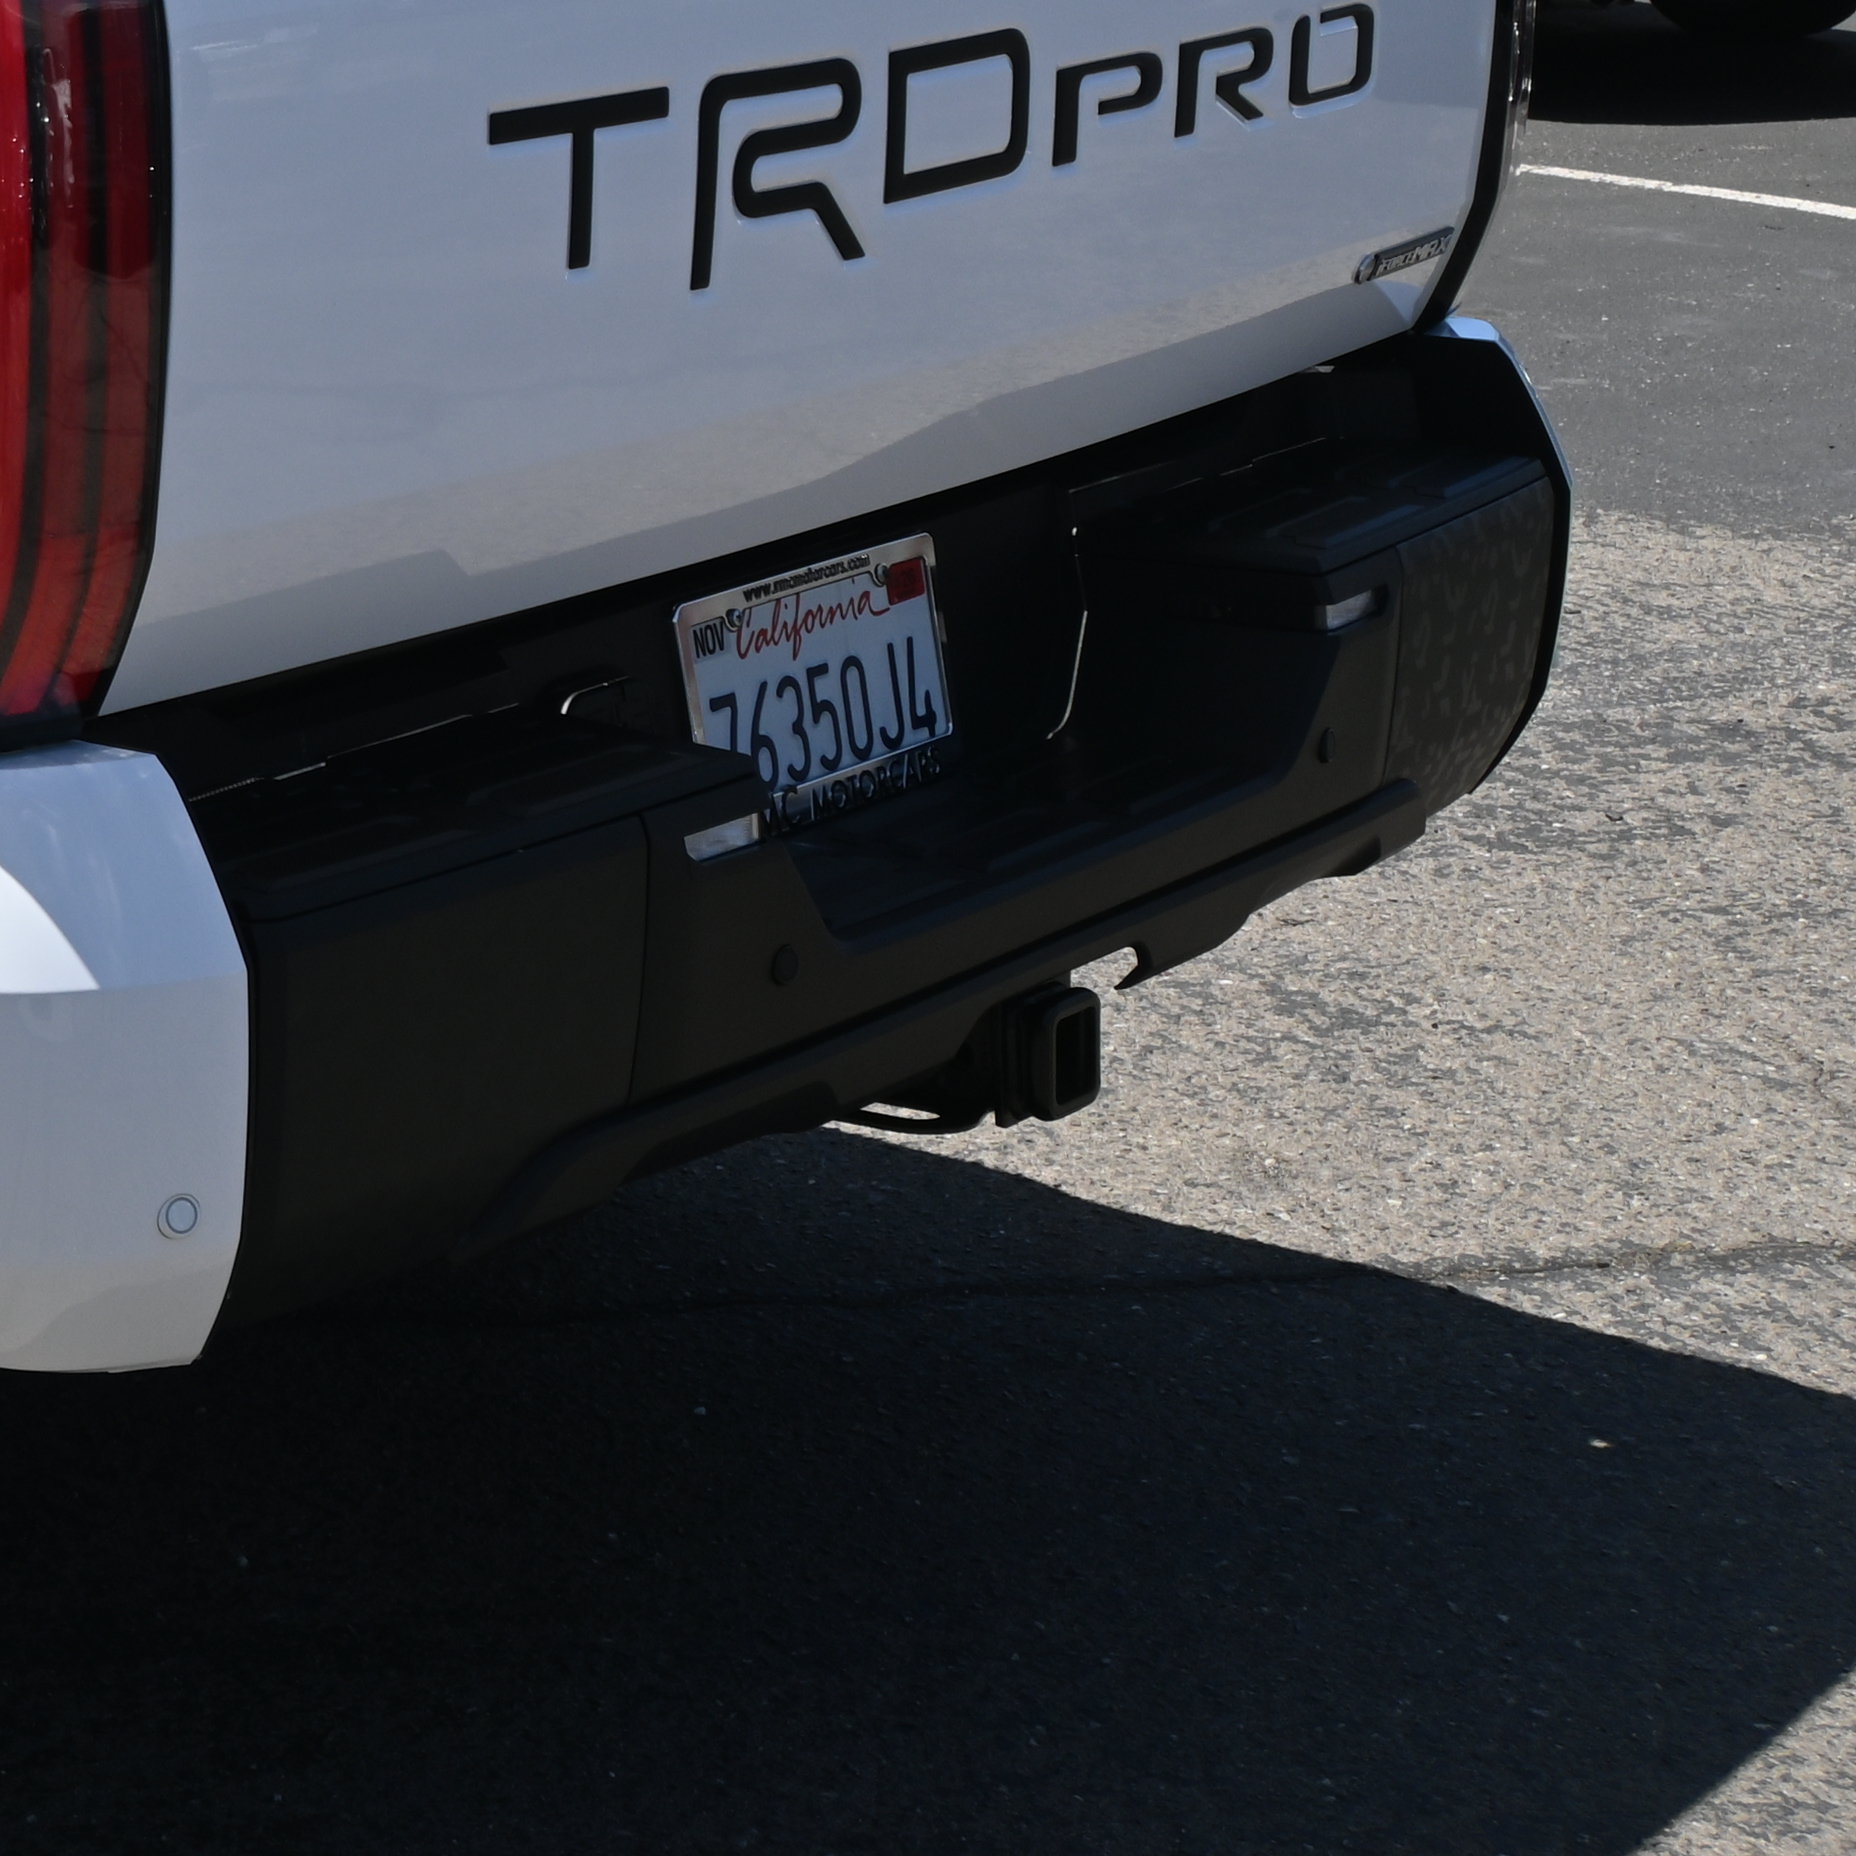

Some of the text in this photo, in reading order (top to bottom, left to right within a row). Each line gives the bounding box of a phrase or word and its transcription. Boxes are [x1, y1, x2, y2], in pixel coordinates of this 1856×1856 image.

[488, 2, 1375, 291] TRD PRO
[693, 588, 890, 662] NOV California
[709, 635, 938, 793] 76350J4
